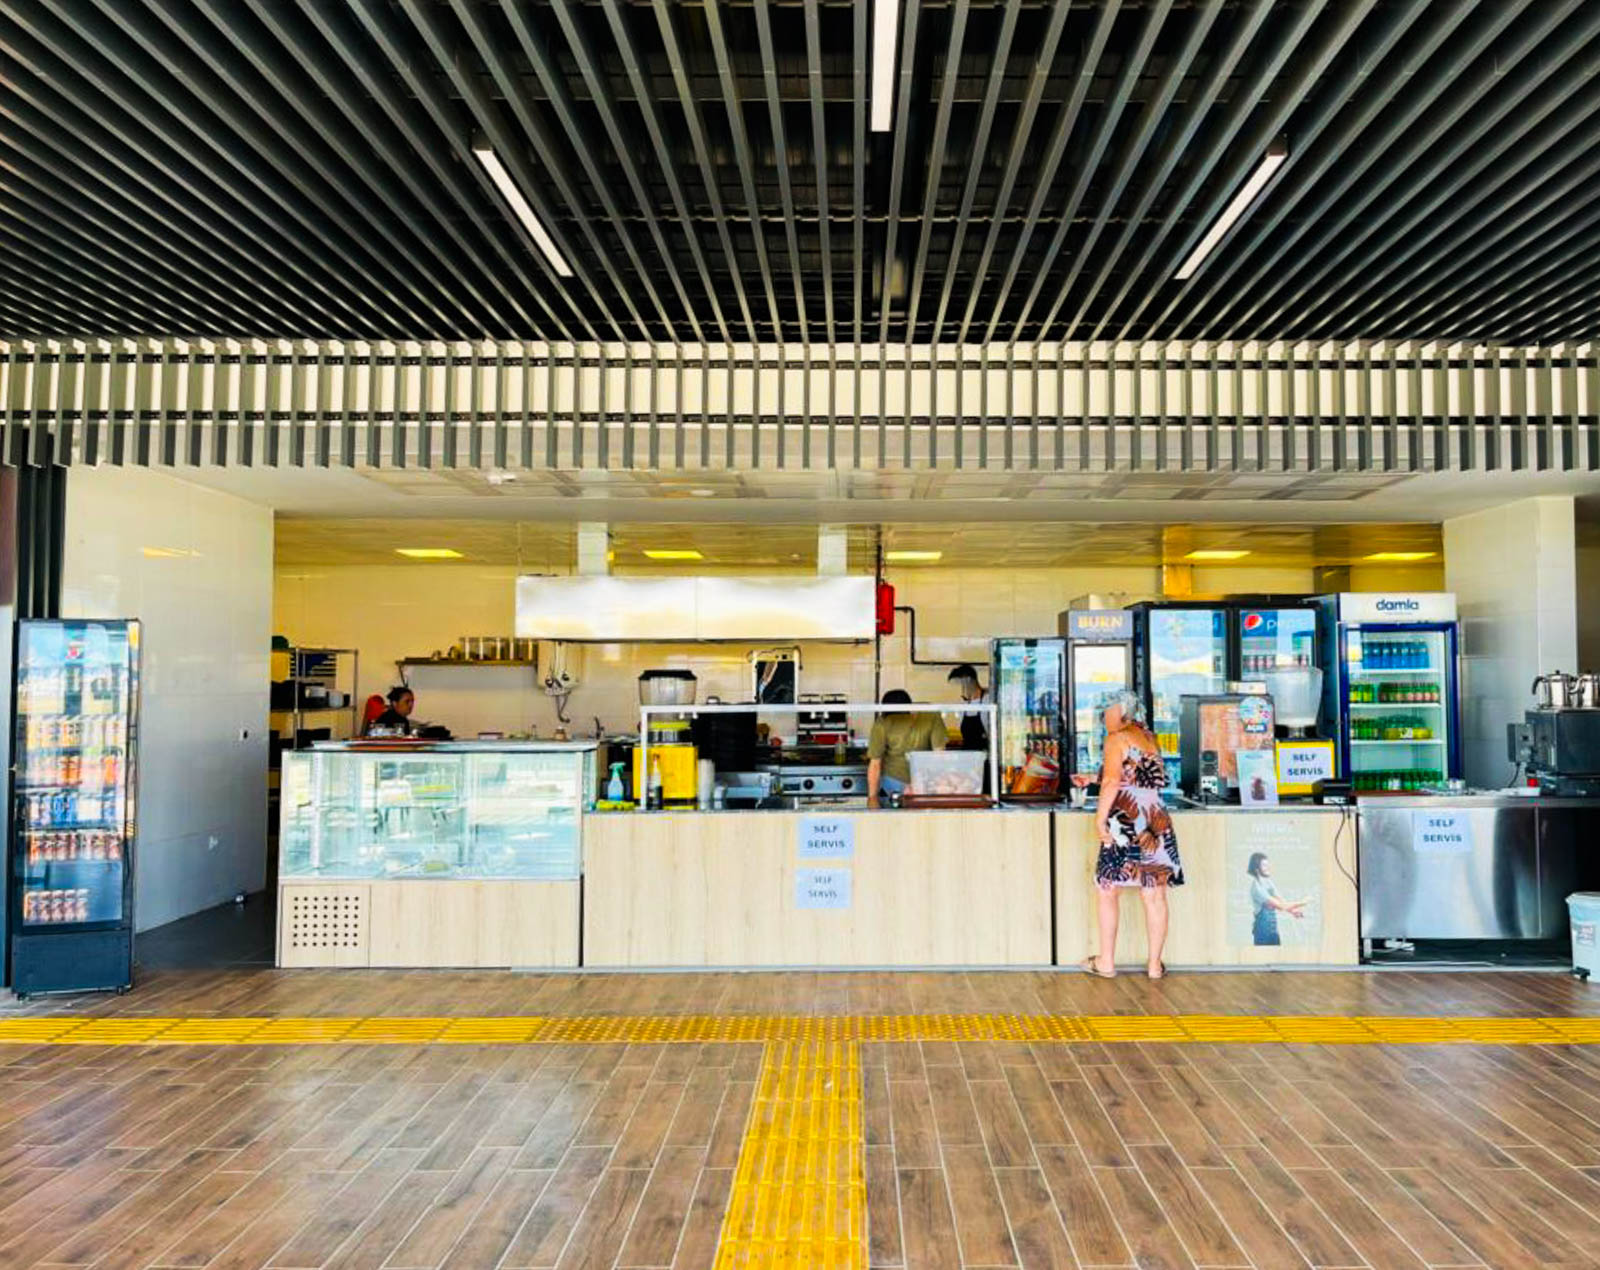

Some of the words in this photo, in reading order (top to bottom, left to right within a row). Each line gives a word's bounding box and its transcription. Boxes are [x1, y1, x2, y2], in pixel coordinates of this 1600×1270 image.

[1375, 598, 1419, 611] damla
[1077, 615, 1123, 628] BURN
[1292, 753, 1316, 762] SELF
[1428, 818, 1455, 828] SELF
[813, 825, 838, 833] SELF
